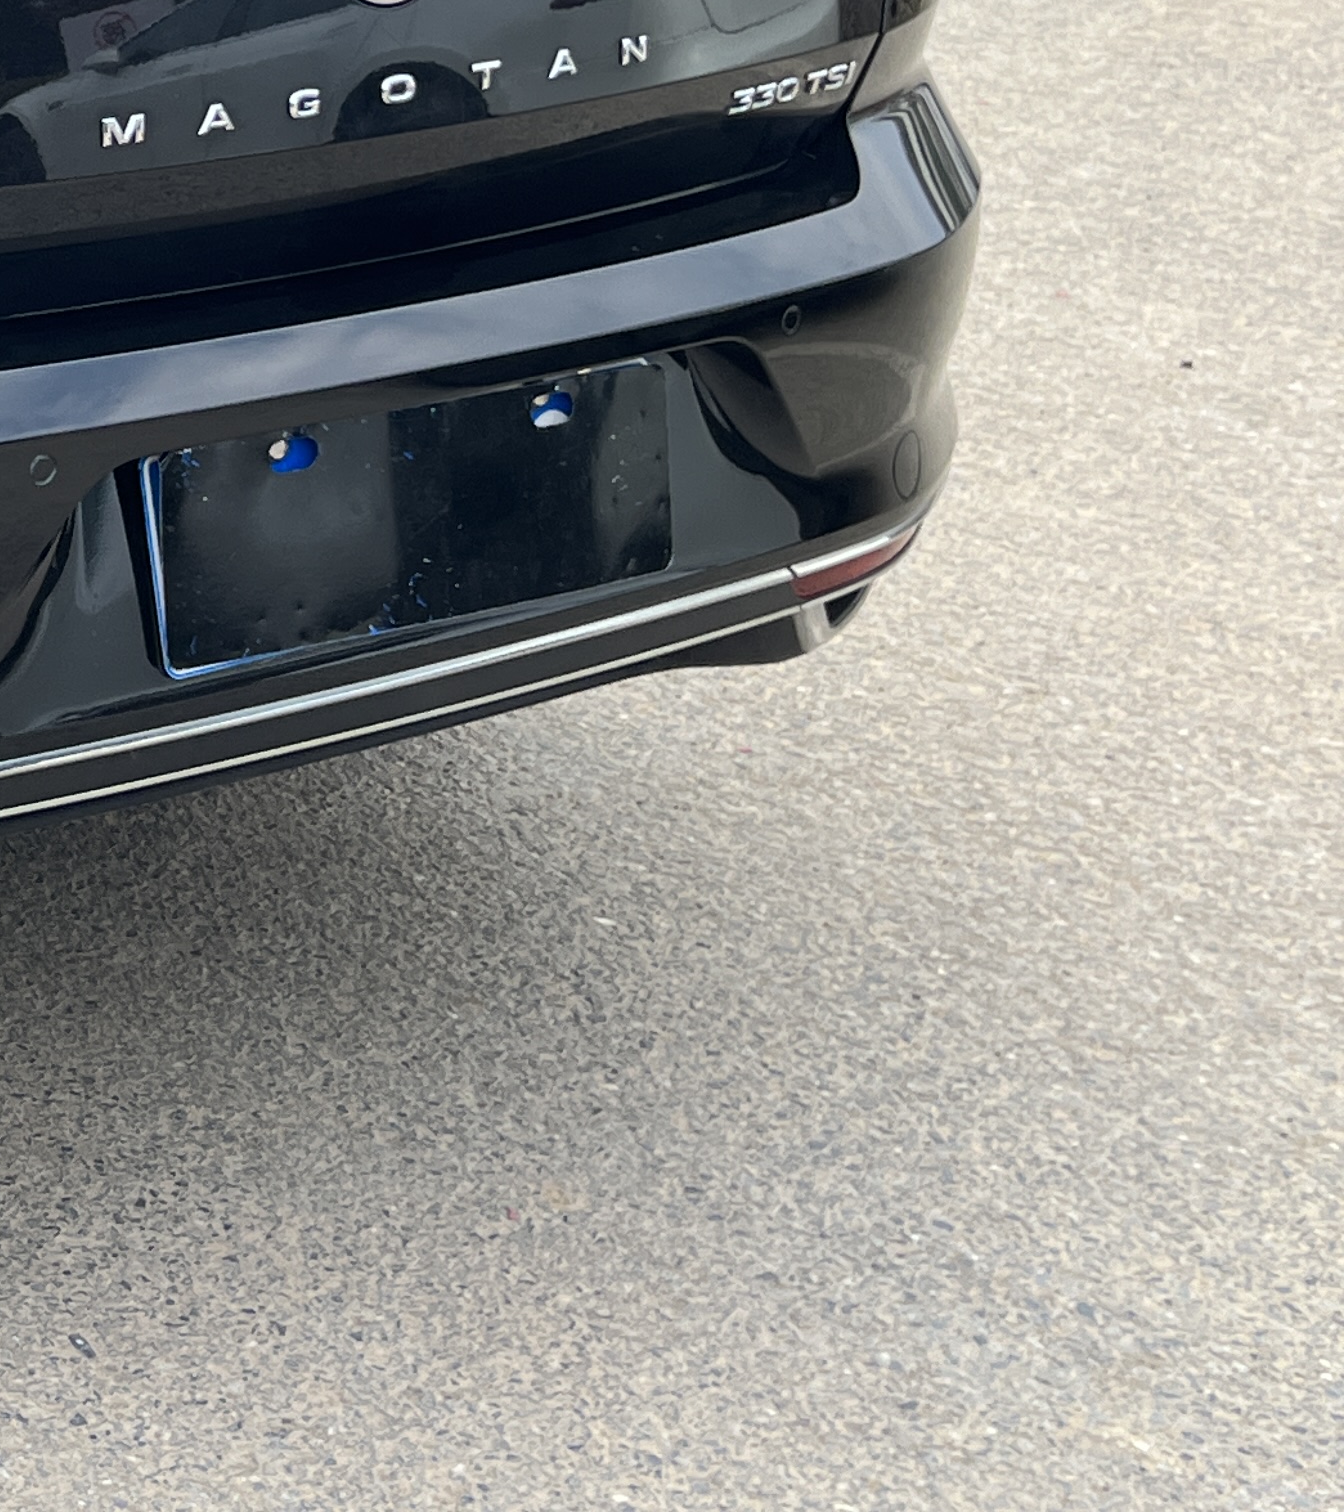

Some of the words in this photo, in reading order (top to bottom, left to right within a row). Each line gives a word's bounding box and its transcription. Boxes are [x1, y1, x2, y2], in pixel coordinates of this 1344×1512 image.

[100, 34, 650, 149] MAGOTAN
[727, 76, 801, 117] 330
[806, 60, 857, 96] TSI
